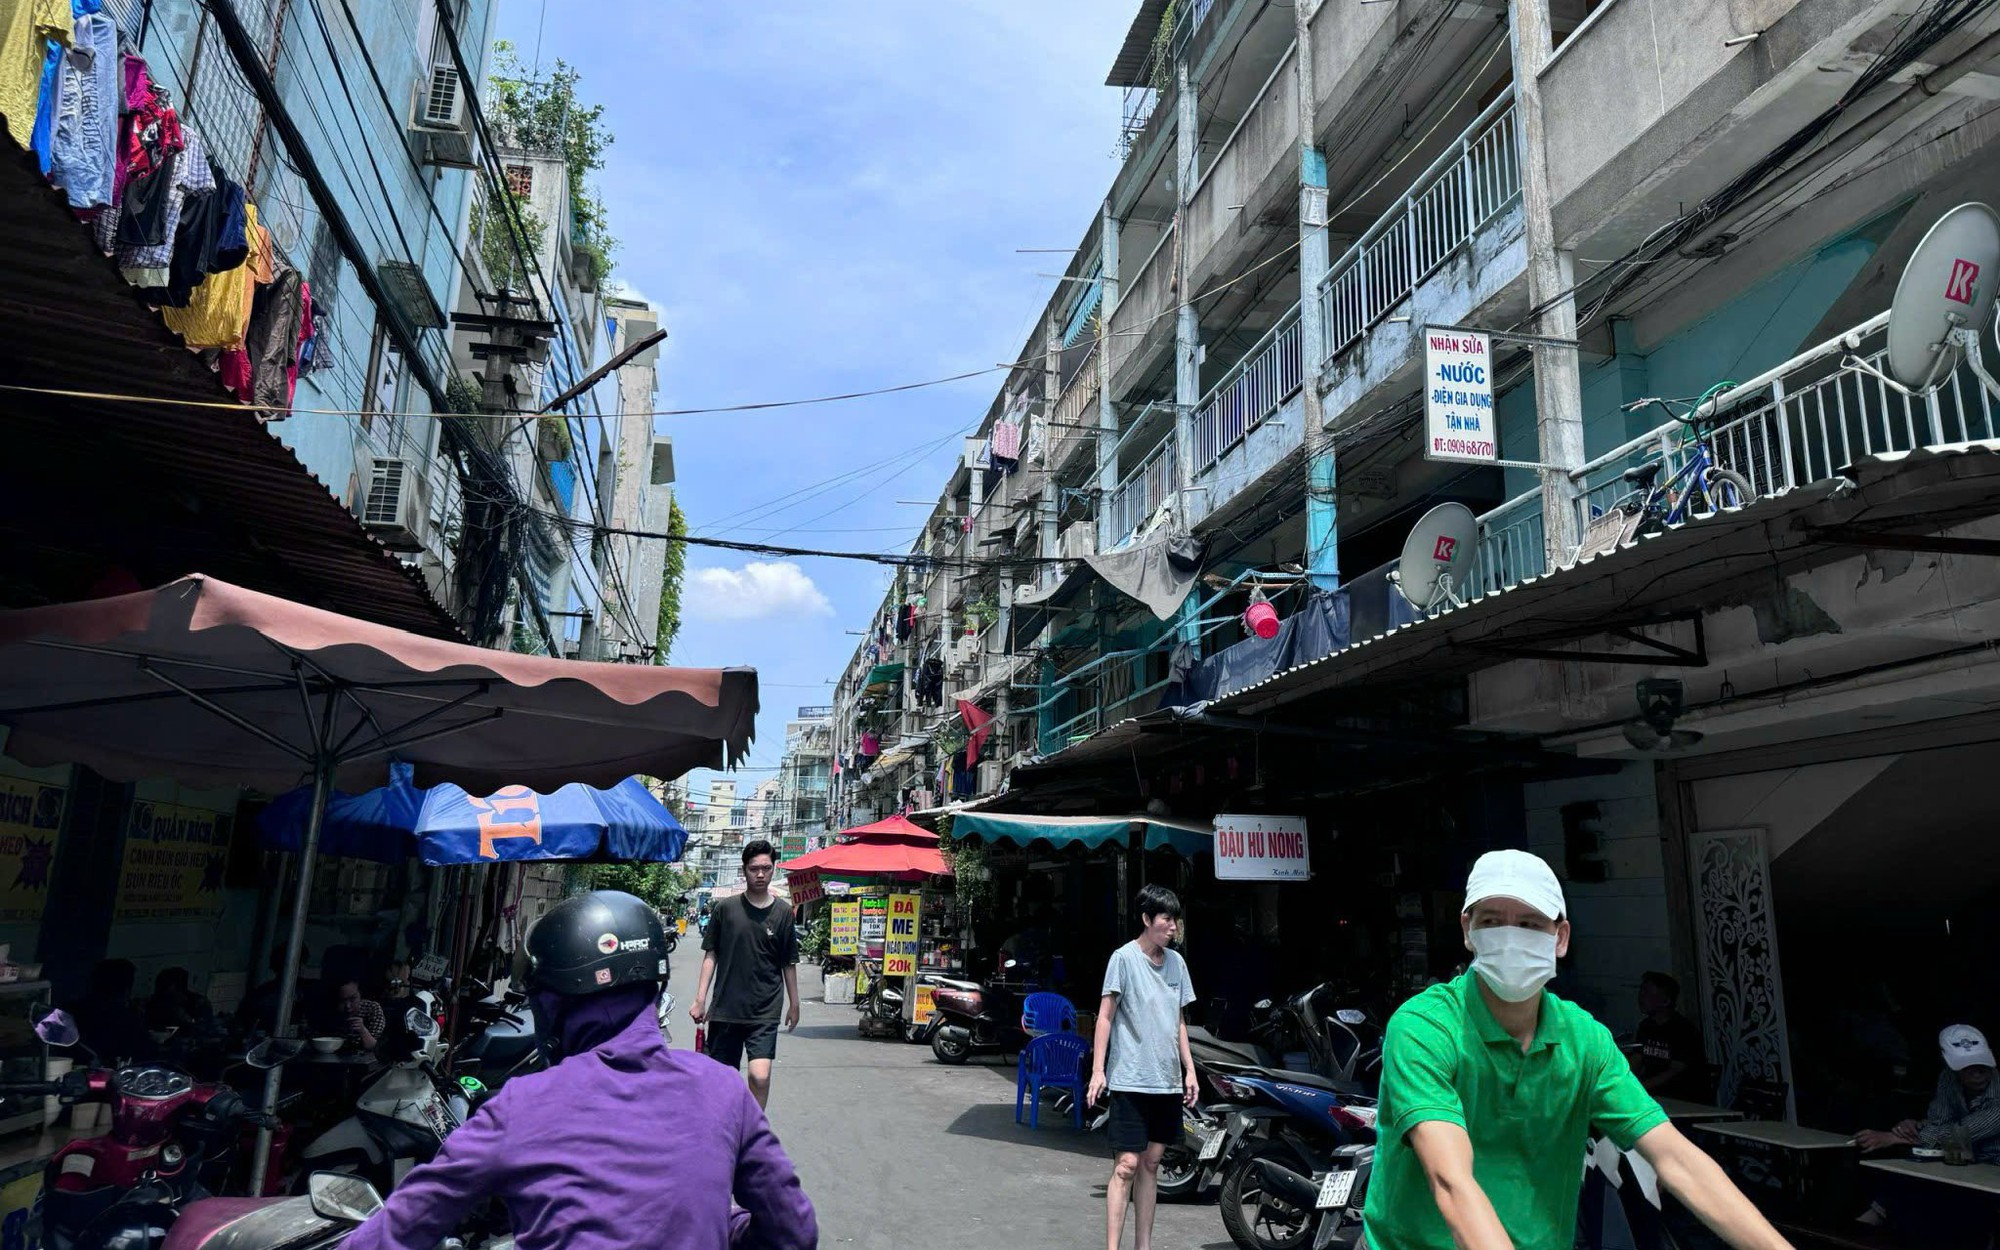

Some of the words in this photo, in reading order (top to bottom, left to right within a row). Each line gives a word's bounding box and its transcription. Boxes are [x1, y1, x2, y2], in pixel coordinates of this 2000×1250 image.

[1430, 334, 1458, 355] NHẬN
[1462, 334, 1484, 355] SỬA
[1455, 391, 1468, 406] GIA
[1470, 394, 1492, 411] DỤNG
[1445, 411, 1462, 432] TẬN
[1464, 413, 1481, 431] NHÀ
[1219, 825, 1244, 864] ĐẬU
[1247, 823, 1265, 858] HỦ
[1267, 826, 1304, 859] NÓNG
[893, 898, 914, 914] ĐÁ
[892, 918, 913, 935] ME
[888, 959, 911, 973] 20k
